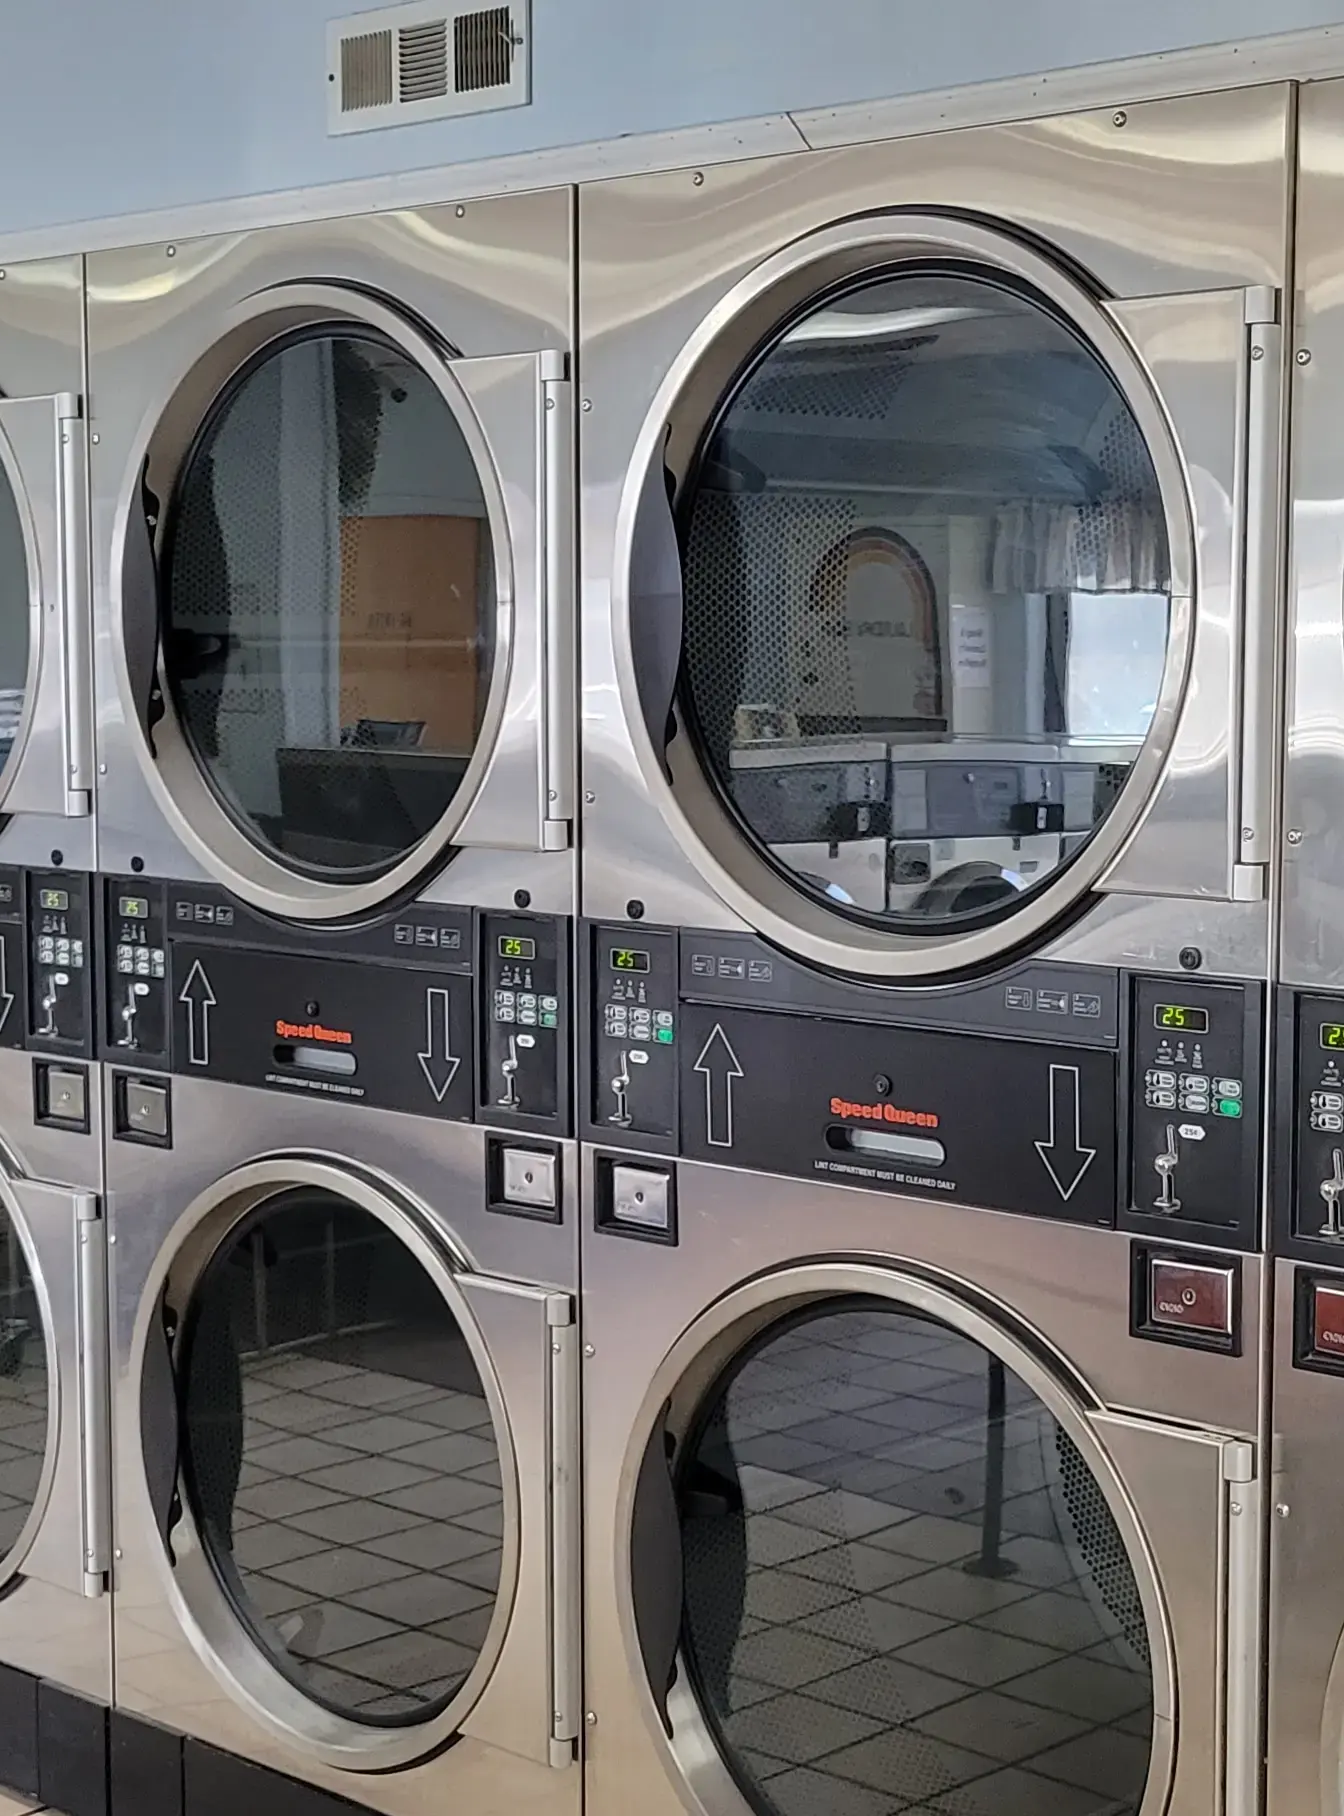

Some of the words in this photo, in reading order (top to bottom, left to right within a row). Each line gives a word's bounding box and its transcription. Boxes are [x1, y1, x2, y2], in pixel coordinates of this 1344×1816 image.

[505, 939, 521, 955] 25
[616, 951, 634, 967] 25
[1162, 1007, 1184, 1026] 25
[276, 1020, 313, 1038] Speed
[830, 1097, 883, 1119] Speed
[884, 1103, 938, 1128] Queen
